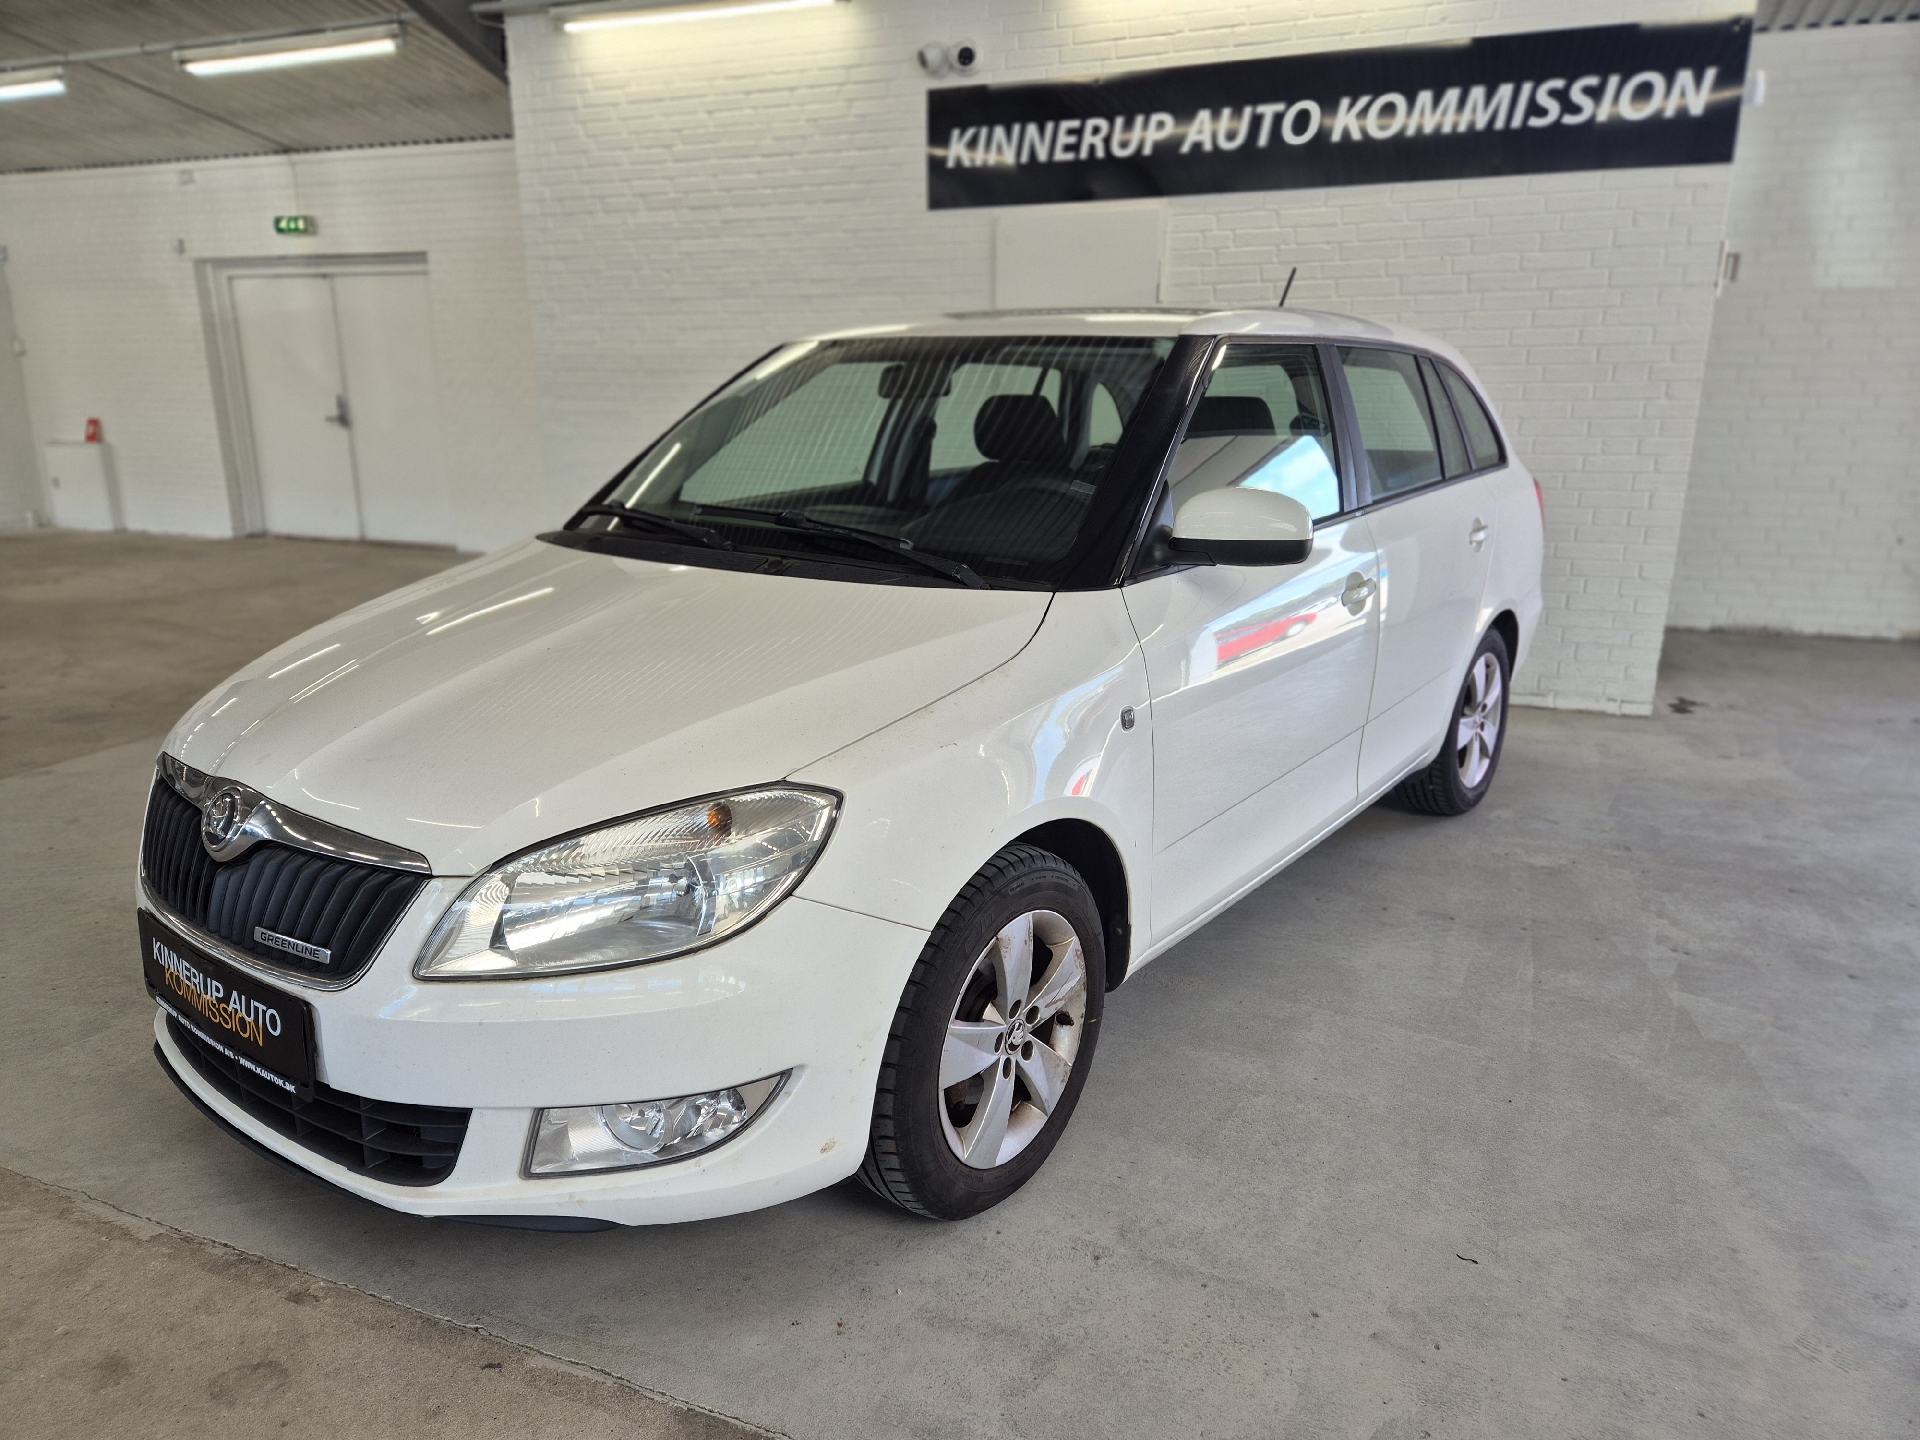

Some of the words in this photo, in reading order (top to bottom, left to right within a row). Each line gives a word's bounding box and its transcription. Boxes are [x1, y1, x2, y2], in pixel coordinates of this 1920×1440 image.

[946, 111, 1175, 169] KINNERUP
[1179, 100, 1321, 154] AUTO
[1330, 66, 1718, 144] KOMMISSION
[152, 936, 224, 1004] KINNERUP
[228, 989, 281, 1037] AUTO
[260, 931, 320, 960] GREENLINE
[164, 965, 263, 1047] KOMMISSION
